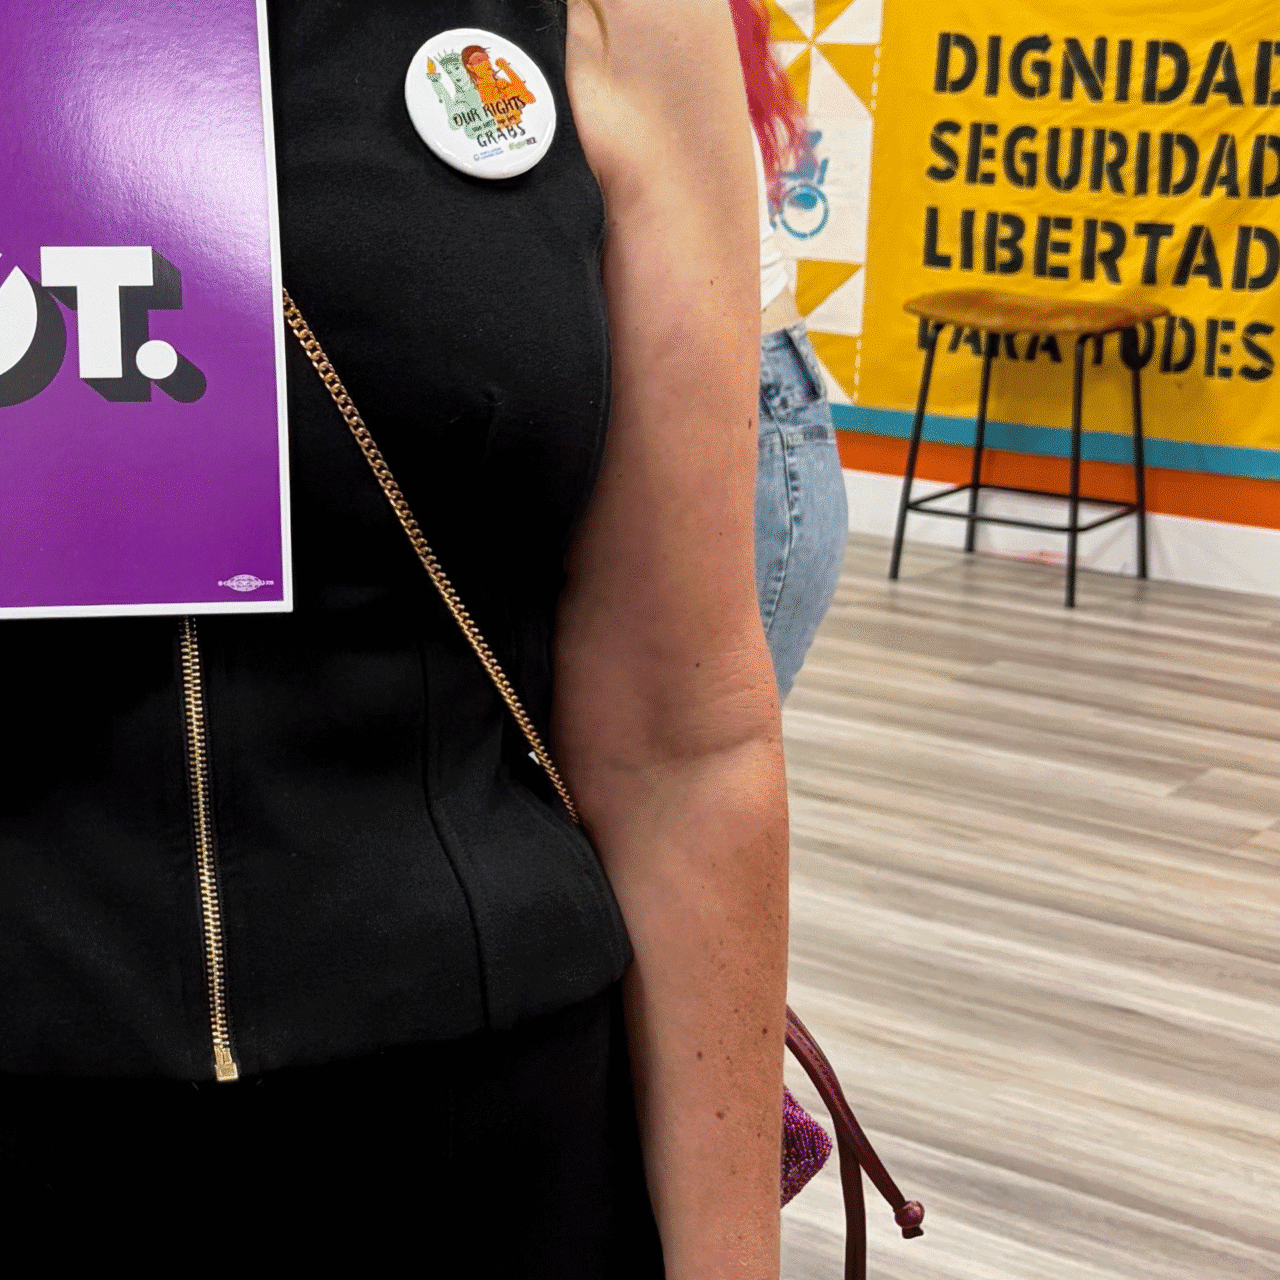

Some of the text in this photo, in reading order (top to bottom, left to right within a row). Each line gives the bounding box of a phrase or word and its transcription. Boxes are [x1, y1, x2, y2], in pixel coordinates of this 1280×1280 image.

[933, 32, 1280, 107] DIGNIDAD
[453, 108, 482, 127] OUR
[483, 95, 526, 118] RIGHTS
[477, 124, 526, 147] GRABS
[926, 120, 1280, 199] SEGURIDAD
[922, 206, 1280, 291] LIBERTAD
